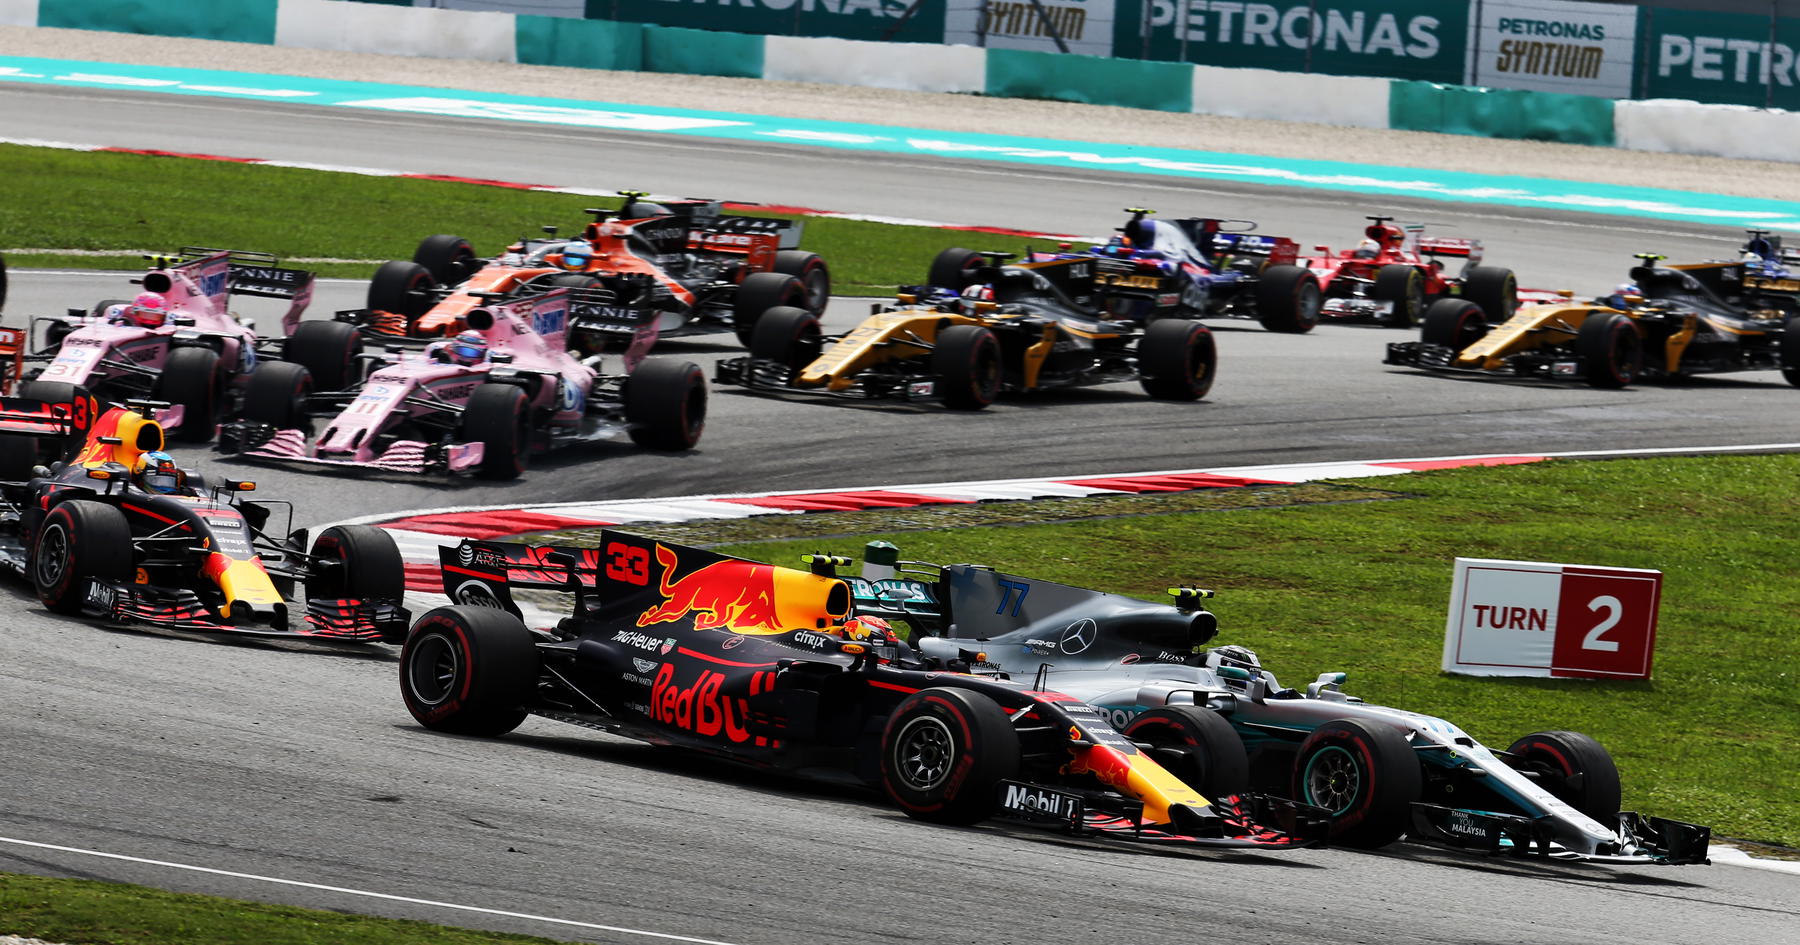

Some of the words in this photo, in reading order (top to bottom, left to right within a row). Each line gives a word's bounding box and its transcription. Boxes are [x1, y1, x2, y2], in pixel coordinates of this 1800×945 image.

[1139, 0, 1440, 59] PETRONAS
[1498, 18, 1605, 40] PETRONAS
[73, 396, 87, 430] 3
[606, 541, 649, 586] 33
[996, 580, 1030, 618] 77
[1473, 605, 1548, 631] TURN
[1582, 595, 1623, 652] 2
[1158, 650, 1187, 663] BOSS
[622, 672, 639, 683] ASTON
[1004, 785, 1060, 814] Mobil
[1451, 810, 1469, 819] THANK
[1460, 818, 1474, 827] YOU
[1451, 823, 1486, 837] MALAYSIA
